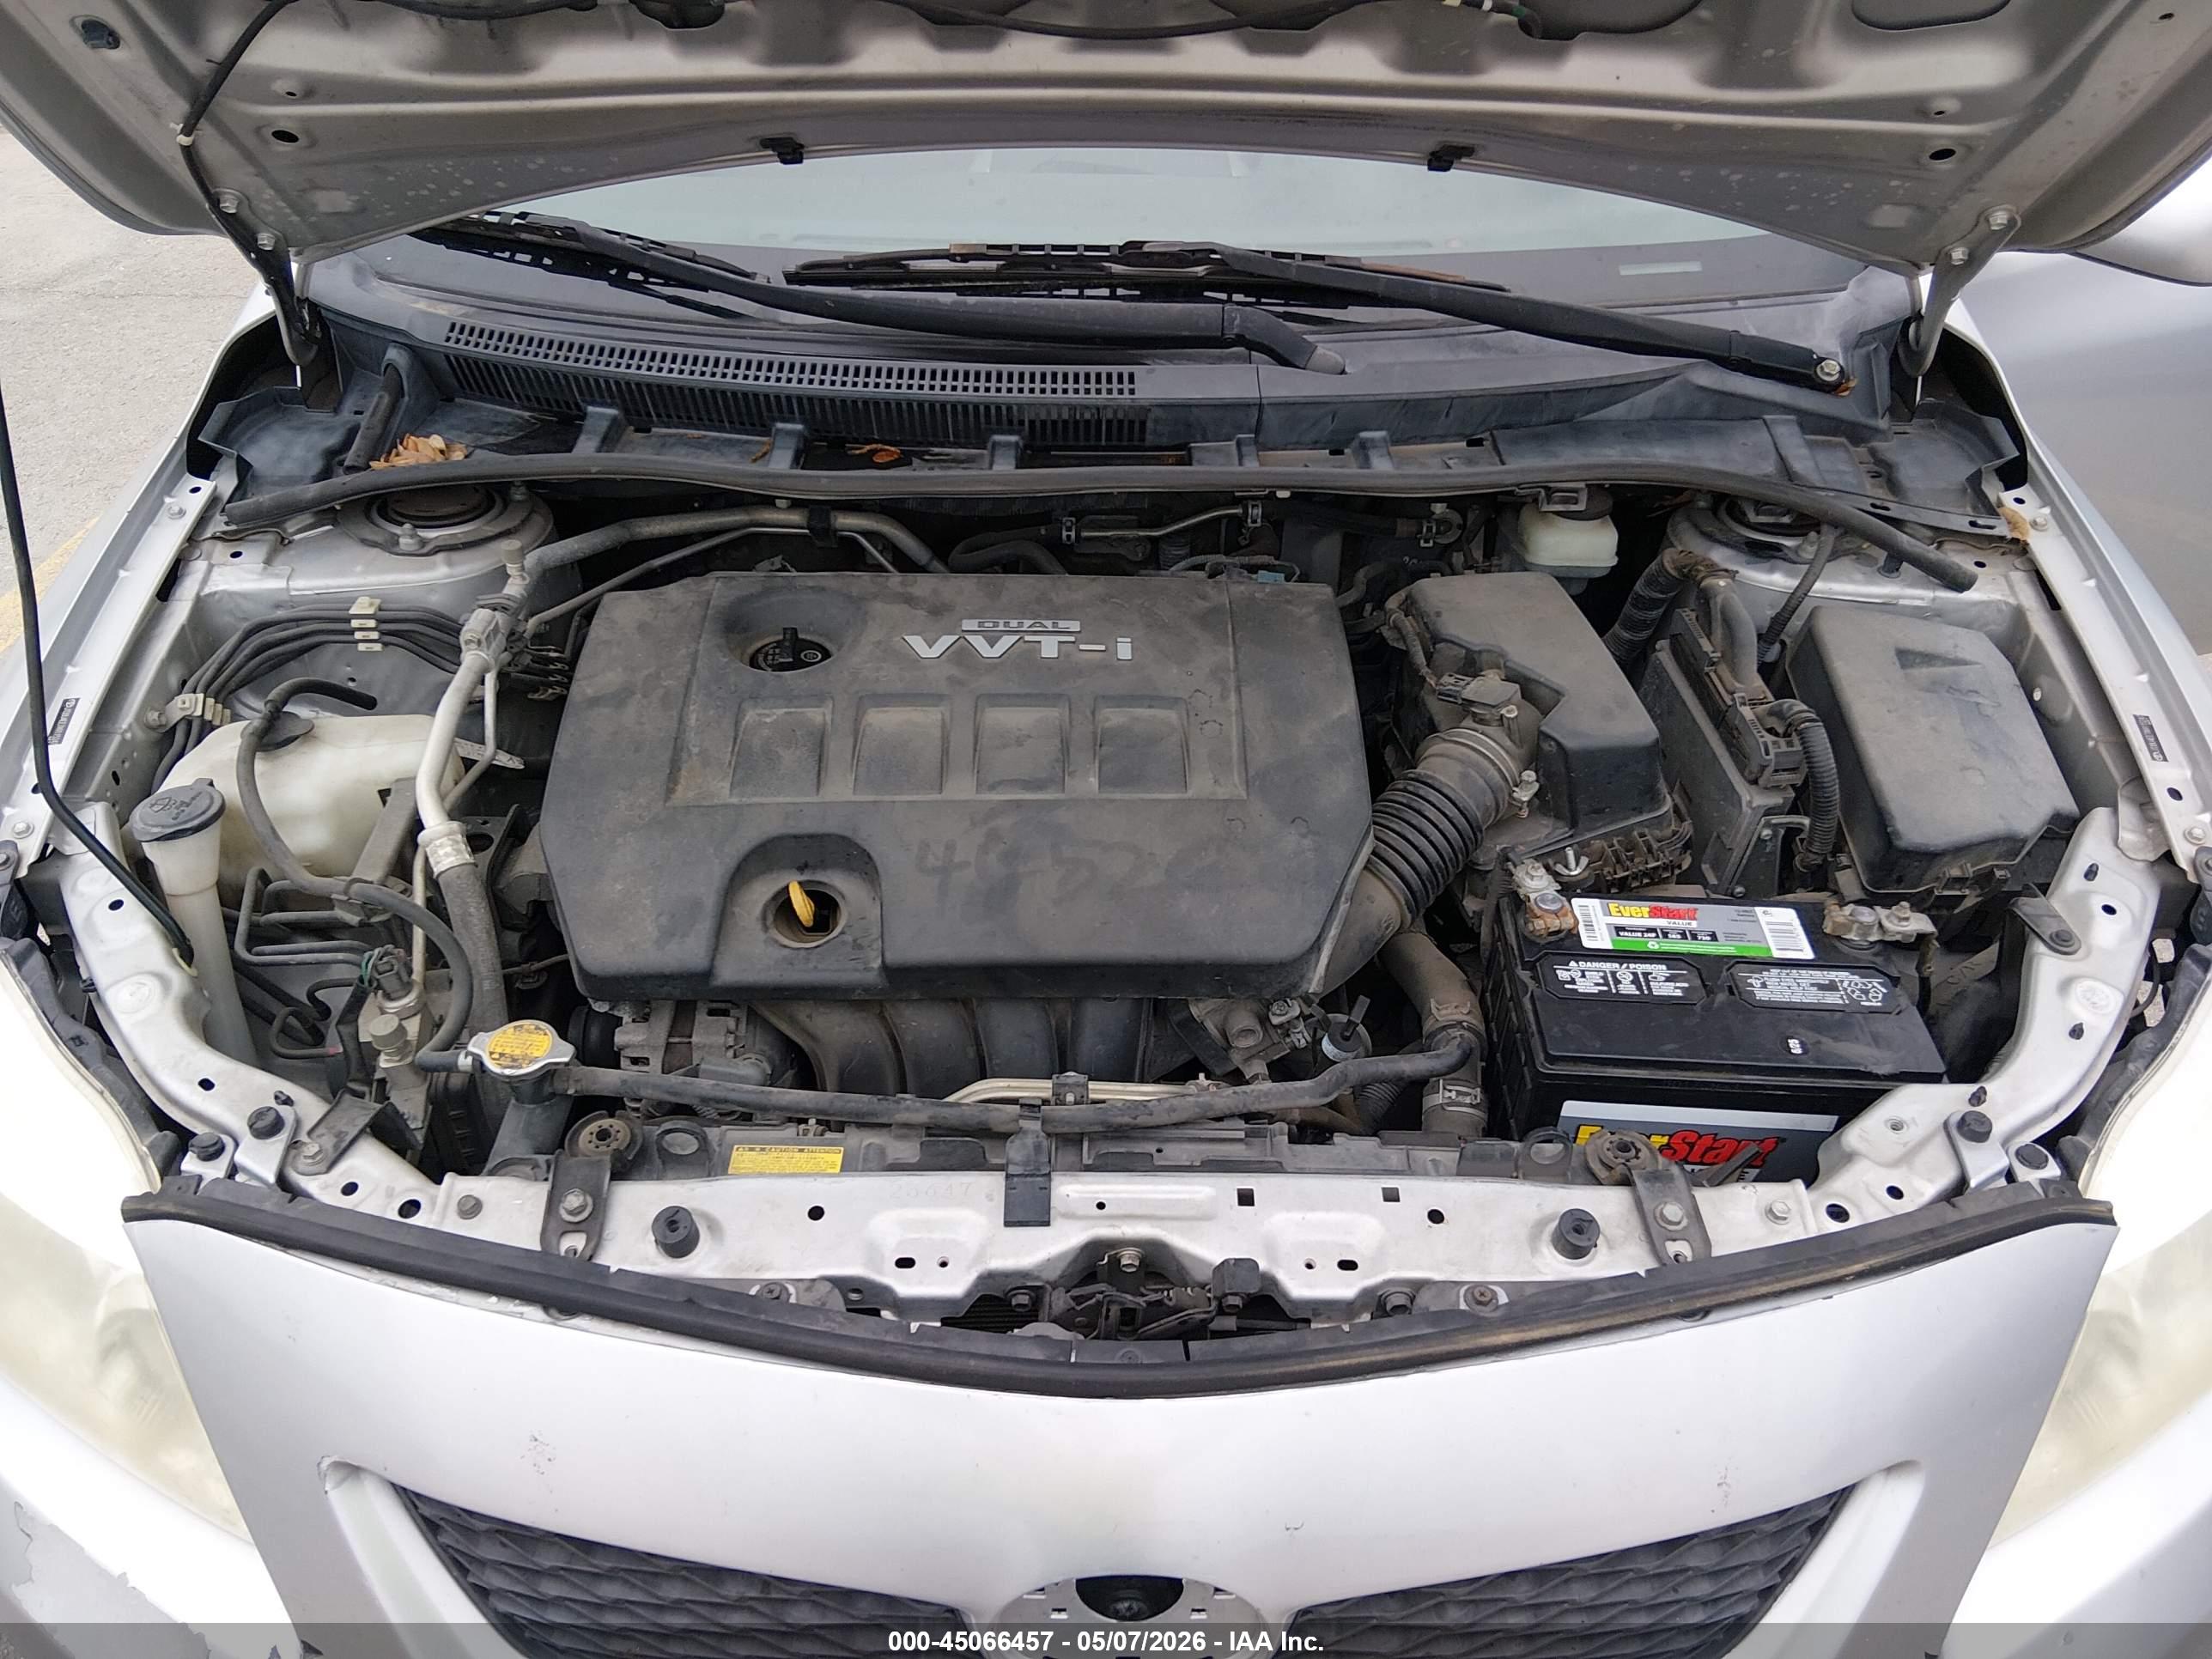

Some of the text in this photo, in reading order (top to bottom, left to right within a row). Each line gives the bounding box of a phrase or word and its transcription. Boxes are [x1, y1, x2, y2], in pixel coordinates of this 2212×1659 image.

[976, 620, 1071, 630] DUAL
[902, 634, 1133, 661] VVT-i
[1607, 902, 1698, 921] EverStart
[1578, 960, 1620, 970] DANGER
[1629, 962, 1668, 971] POISON
